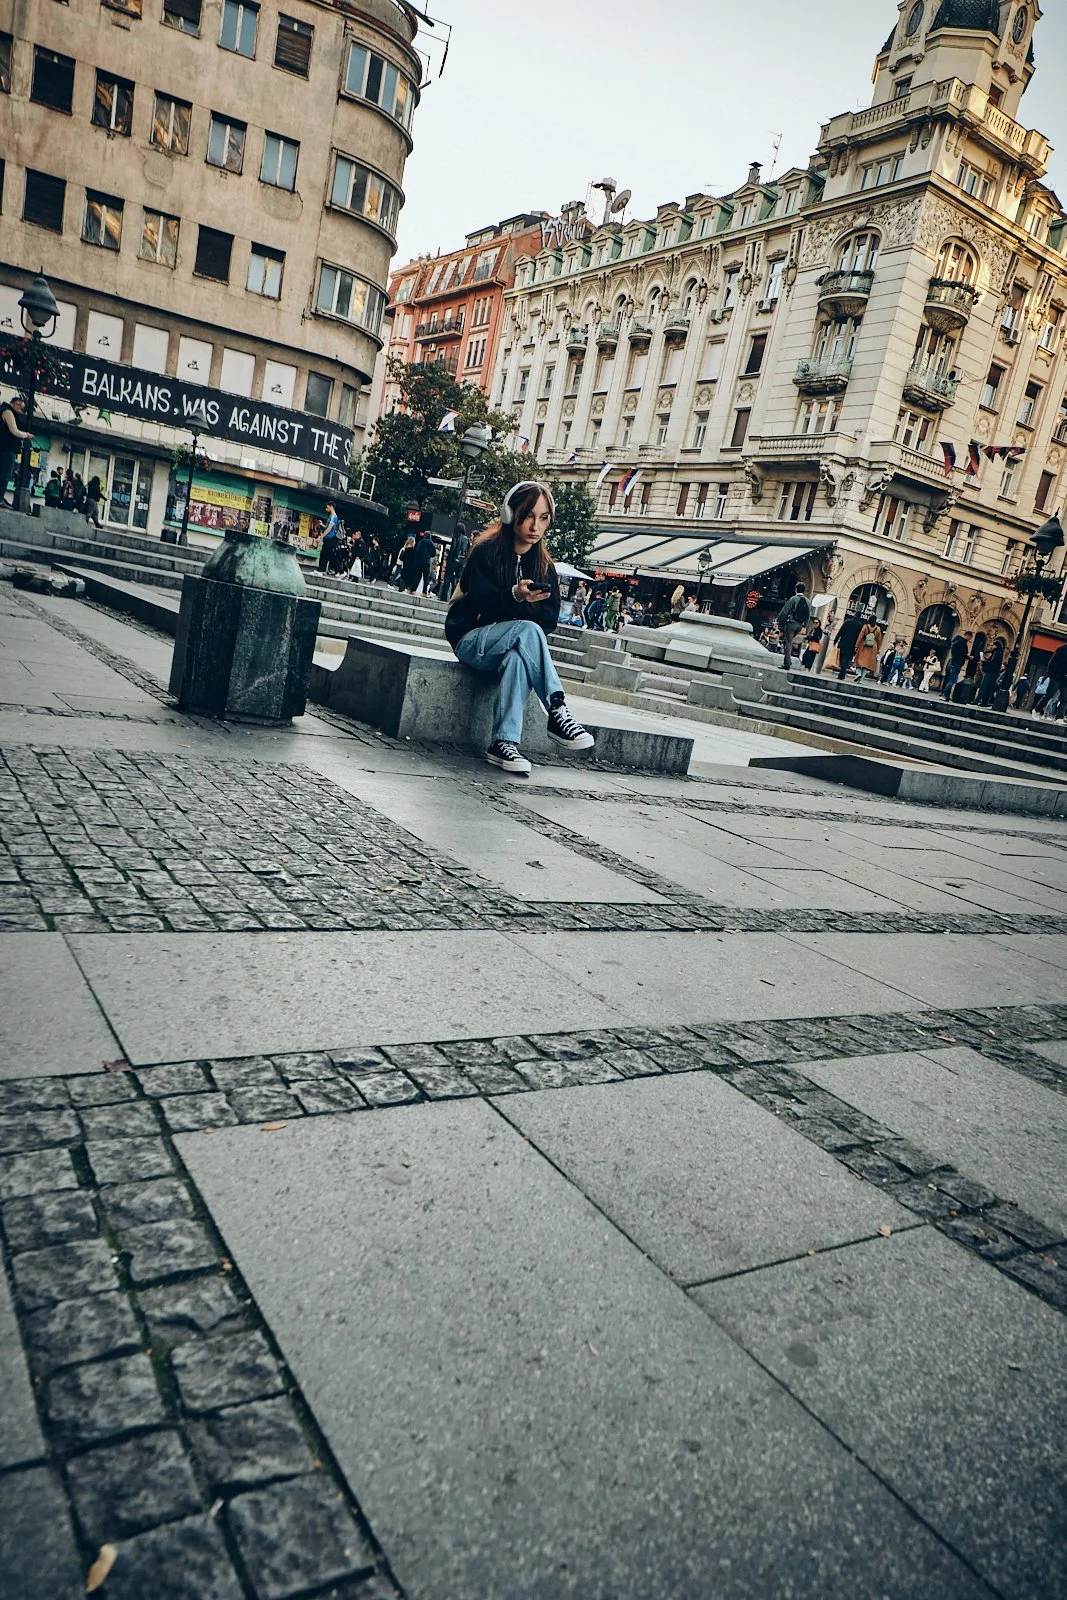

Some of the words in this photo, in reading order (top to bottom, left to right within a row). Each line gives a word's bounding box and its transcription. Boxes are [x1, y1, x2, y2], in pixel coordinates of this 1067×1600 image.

[182, 393, 220, 425] WAS
[228, 406, 304, 445] AGAINST
[311, 428, 342, 460] THE
